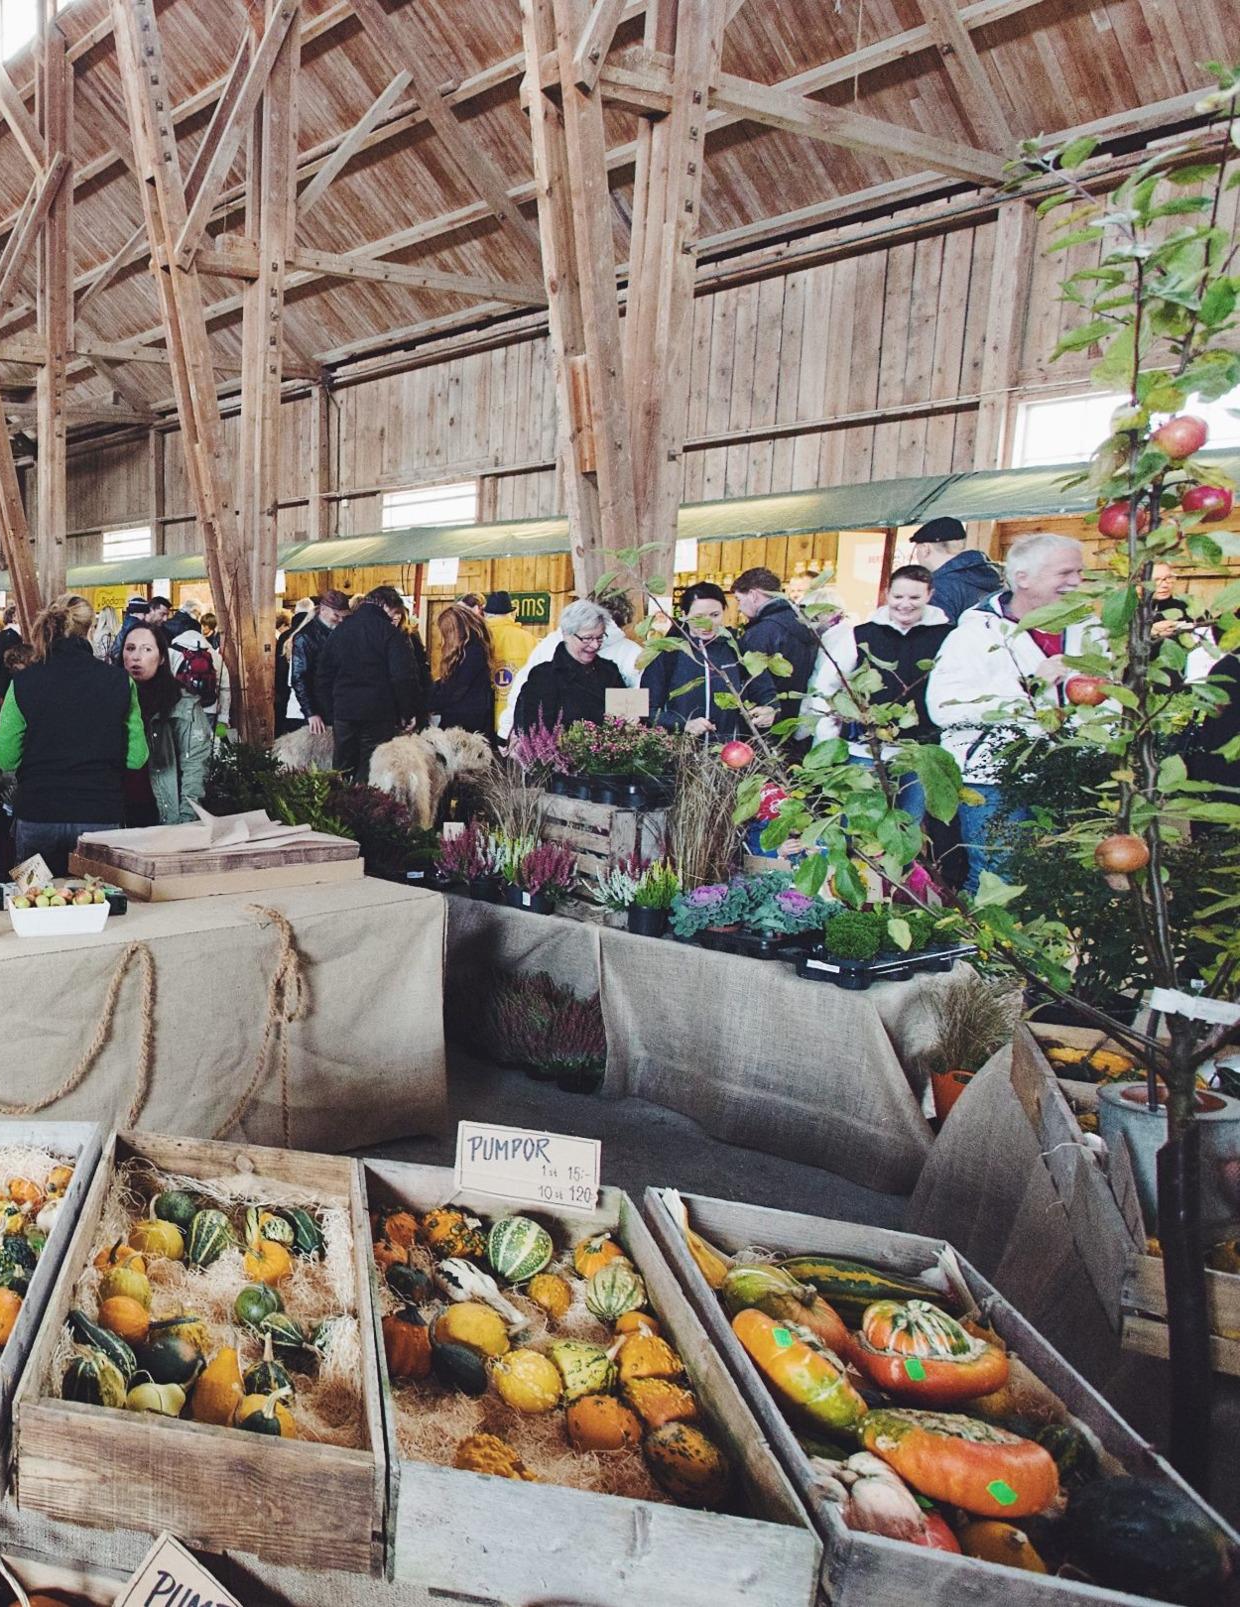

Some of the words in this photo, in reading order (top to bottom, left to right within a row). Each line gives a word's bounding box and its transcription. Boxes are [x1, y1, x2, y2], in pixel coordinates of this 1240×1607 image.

[511, 598, 545, 616] ams
[467, 1136, 551, 1163] PUMPOR
[144, 1570, 230, 1607] PU
